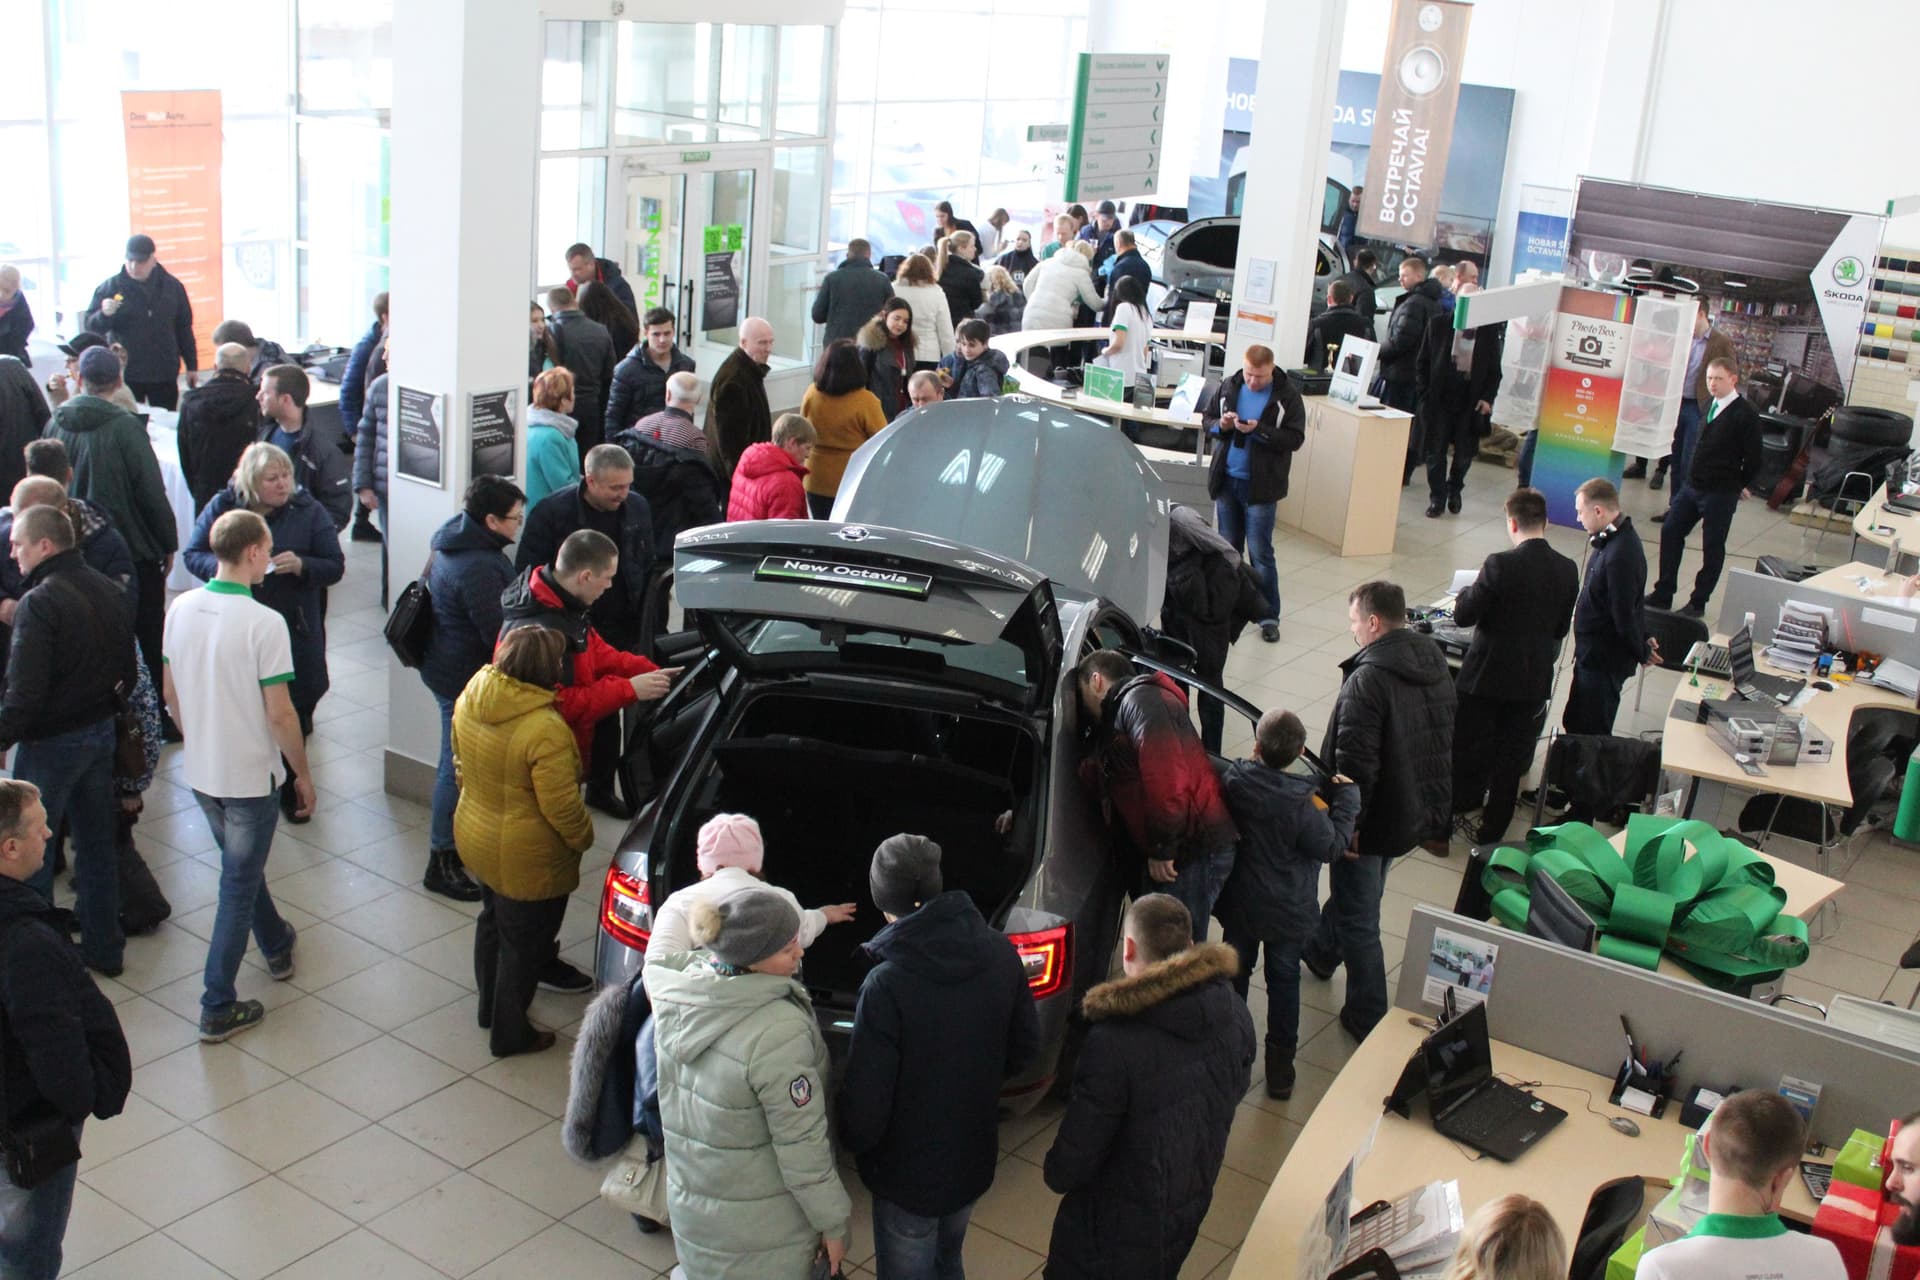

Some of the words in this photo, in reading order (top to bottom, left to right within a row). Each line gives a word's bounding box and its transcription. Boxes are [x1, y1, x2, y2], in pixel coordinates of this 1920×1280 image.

[1224, 92, 1256, 112] НОВ
[1332, 105, 1356, 125] DA
[1379, 108, 1413, 223] ВСТРЕЧАЙ
[1400, 128, 1431, 226] OCTAVIA!
[1527, 245, 1561, 257] OCTAVIA
[1571, 320, 1597, 335] Photo
[1598, 323, 1617, 337] Box
[783, 560, 829, 573] New
[833, 566, 908, 583] Octavia
